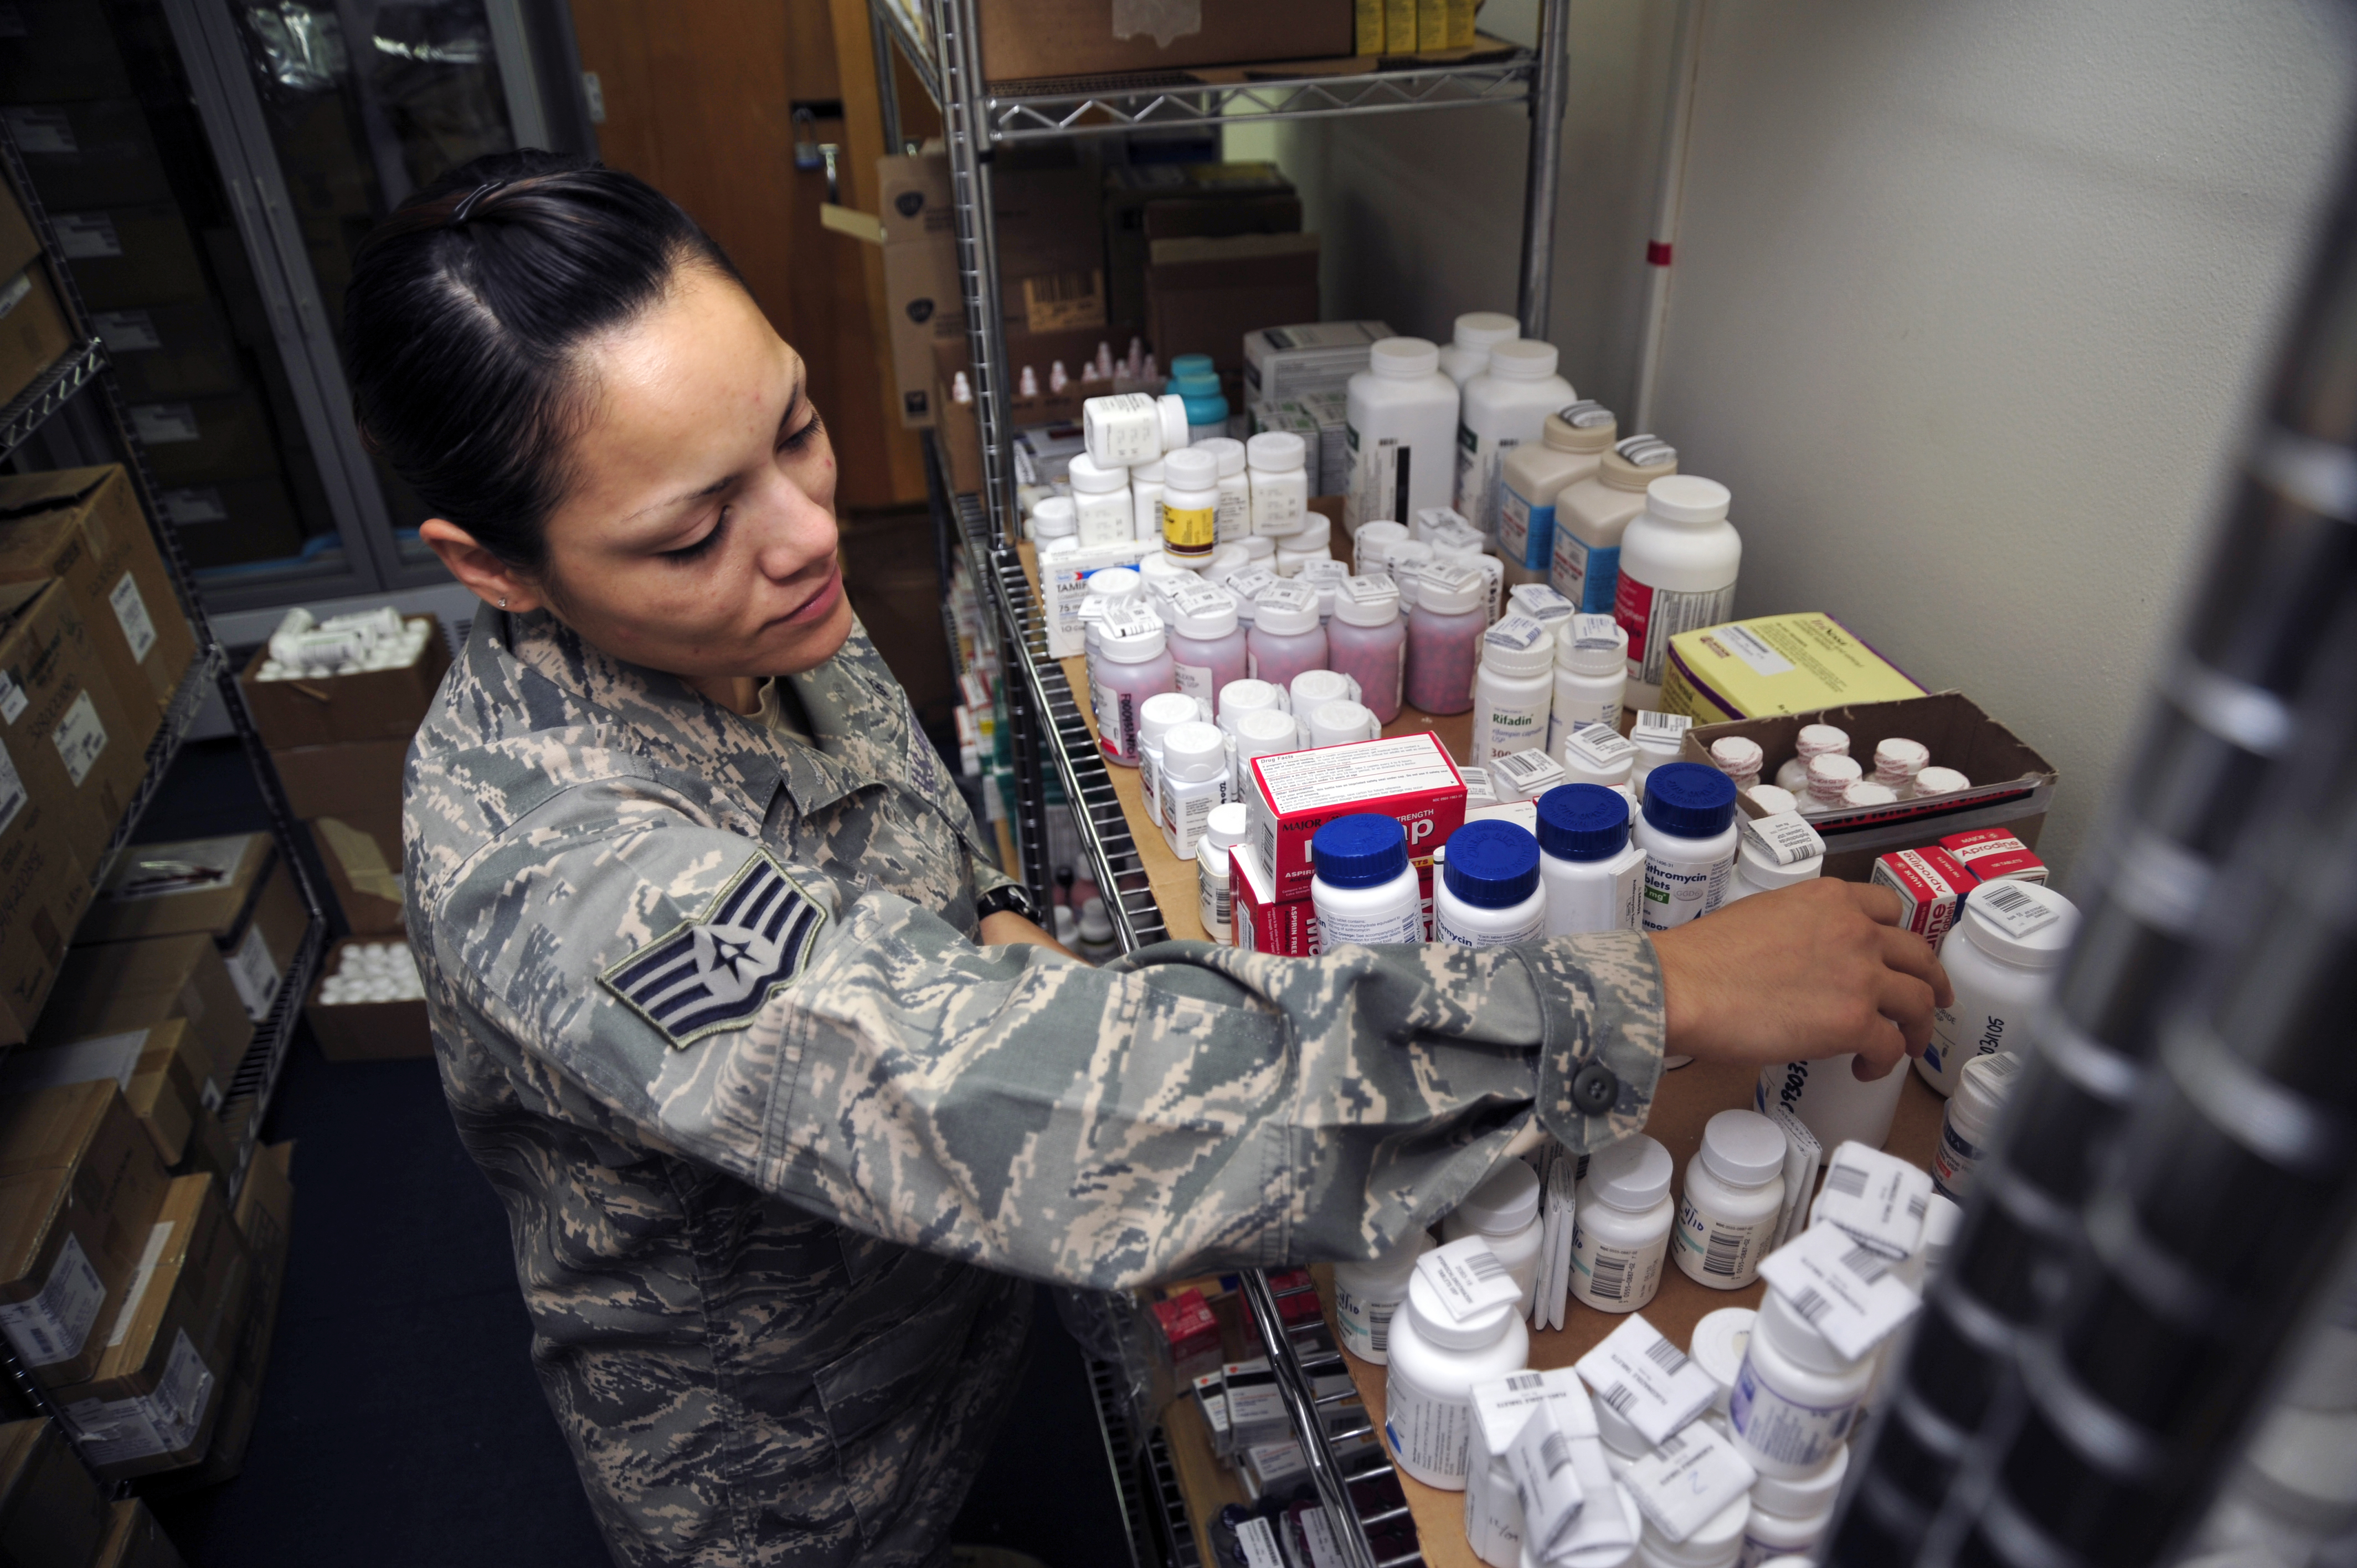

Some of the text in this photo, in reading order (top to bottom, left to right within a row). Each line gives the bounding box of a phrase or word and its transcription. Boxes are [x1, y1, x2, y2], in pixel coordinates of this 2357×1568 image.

[1057, 582, 1088, 592] TAMIF
[1493, 713, 1533, 726] Rifadin
[1396, 808, 1434, 822] TRENGTH
[1282, 818, 1321, 832] MAJOR
[1784, 837, 1812, 847] Clindamycin
[1961, 834, 1986, 844] MAJOR
[1962, 840, 2020, 857] Aprodine
[1936, 856, 1953, 872] TABLETS
[2000, 859, 2023, 867] TABLETS
[1285, 869, 1315, 878] ASPIRI
[1645, 859, 1707, 884] ithromycin
[1903, 851, 1947, 893] Aprodine
[1904, 869, 1924, 888] MAJOR
[1645, 874, 1670, 891] blets
[1940, 900, 1957, 933] Tablets
[1642, 919, 1669, 931] NDOZ
[1684, 1207, 1704, 1231] 4/10
[1736, 1239, 1751, 1274] 0555-0887-02
[1623, 1263, 1635, 1298] 0555-0887-02
